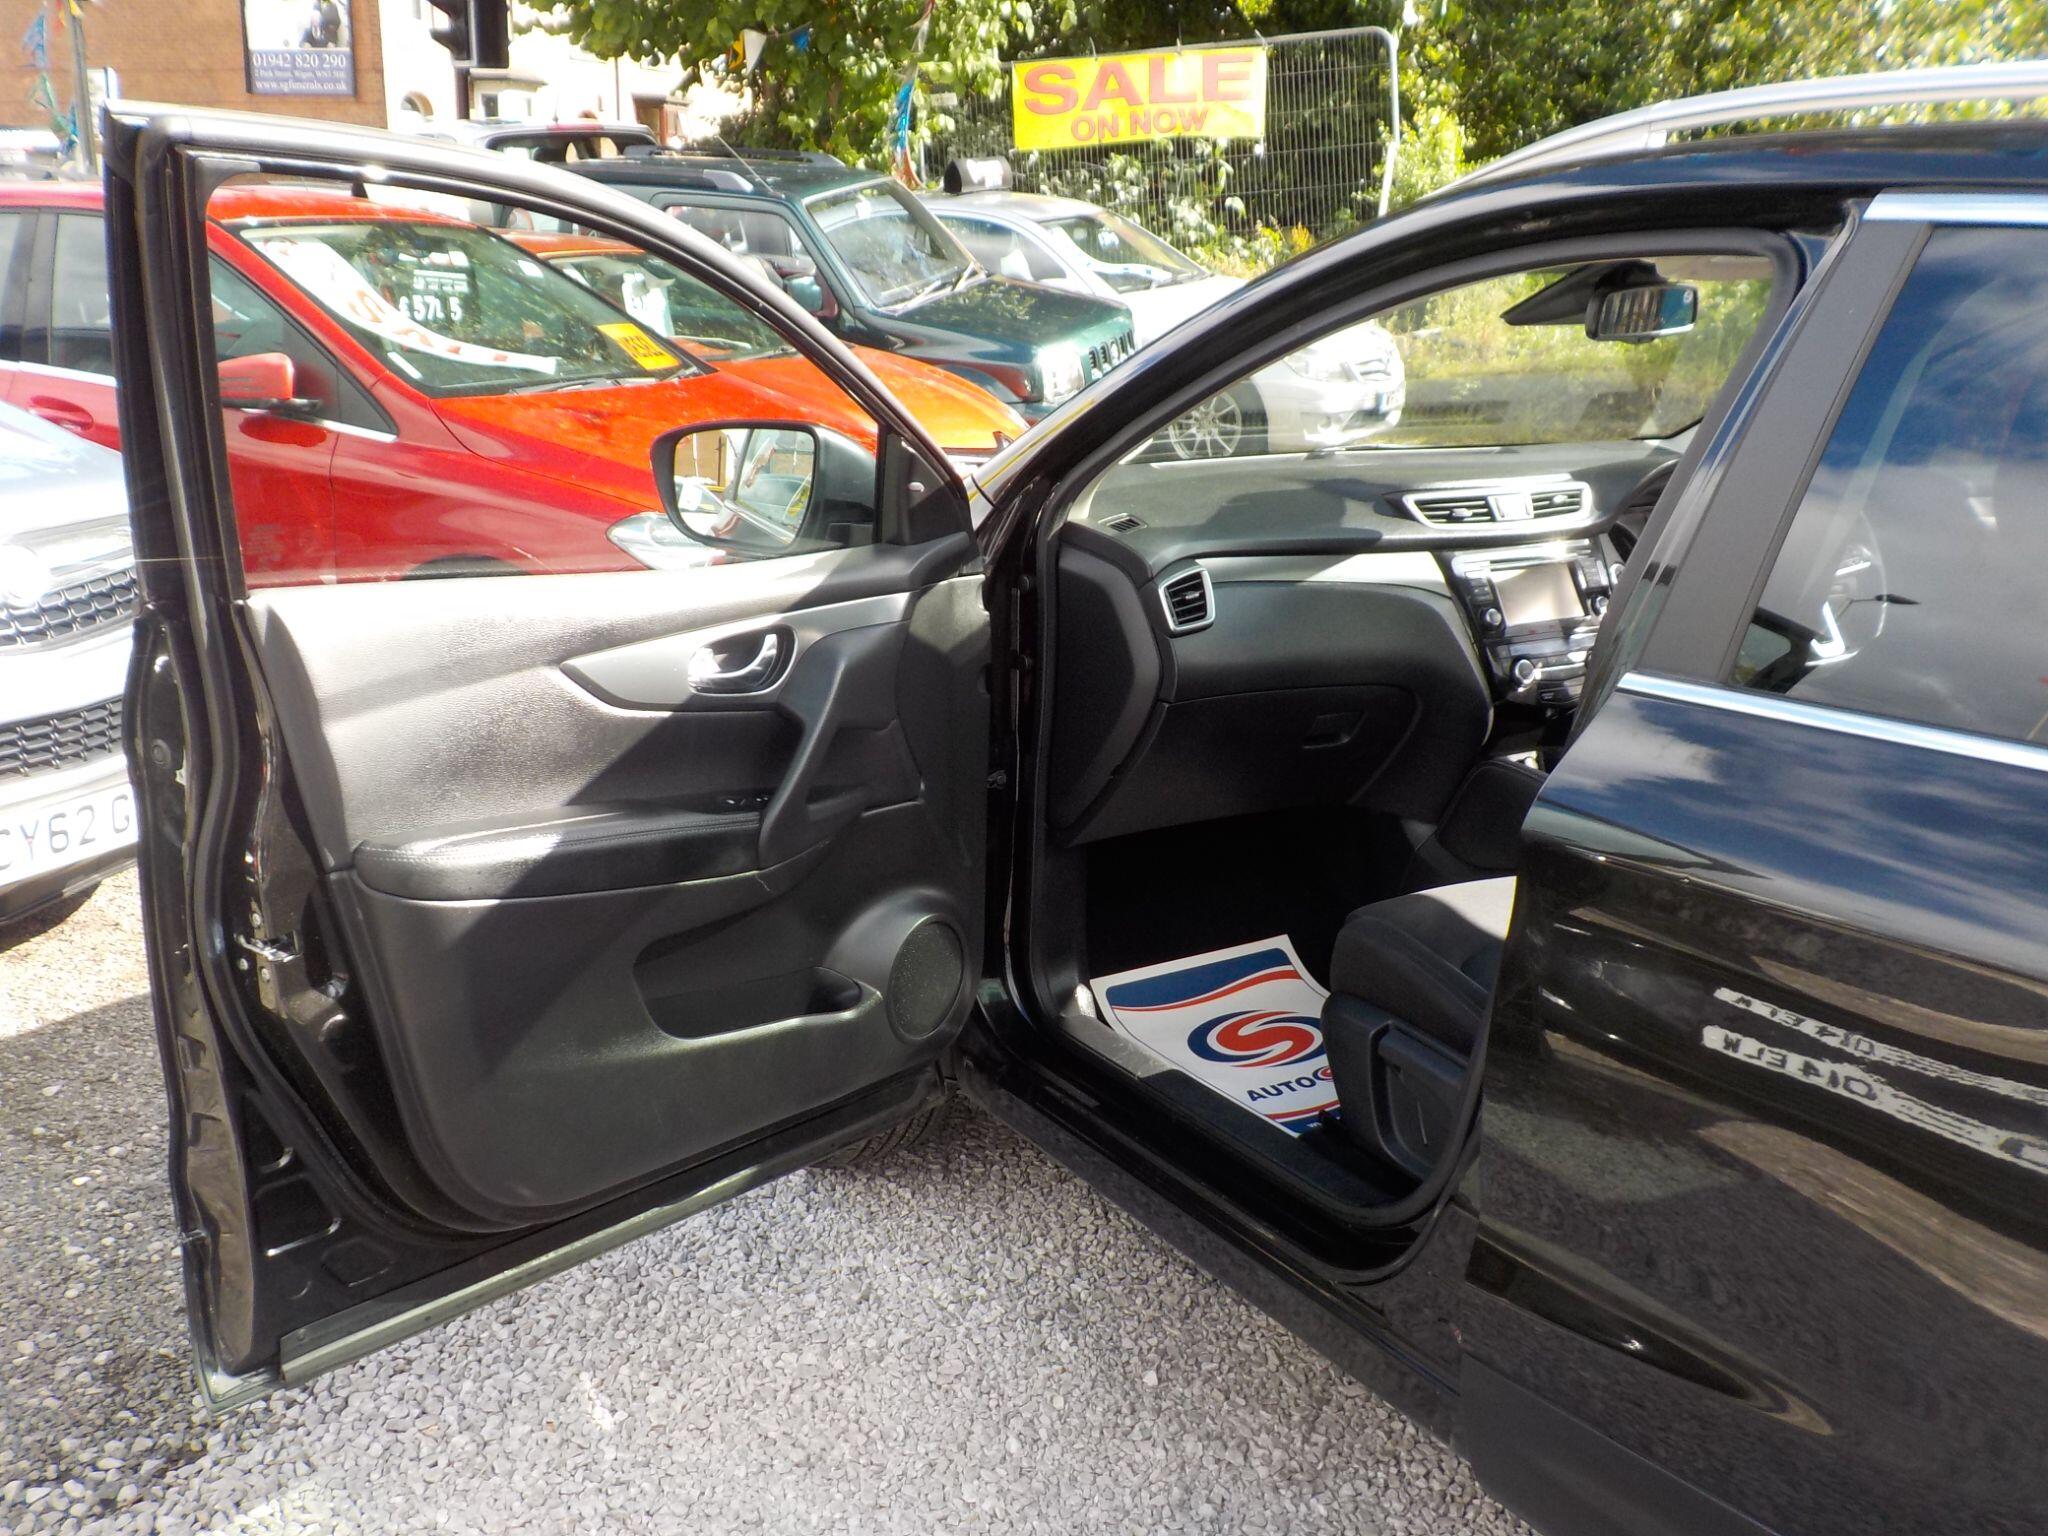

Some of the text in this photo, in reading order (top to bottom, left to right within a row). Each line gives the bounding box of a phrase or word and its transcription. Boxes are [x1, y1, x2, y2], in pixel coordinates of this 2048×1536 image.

[253, 54, 347, 68] 01942 820 290
[1024, 54, 1254, 116] SALE
[1071, 108, 1209, 142] ON NOW
